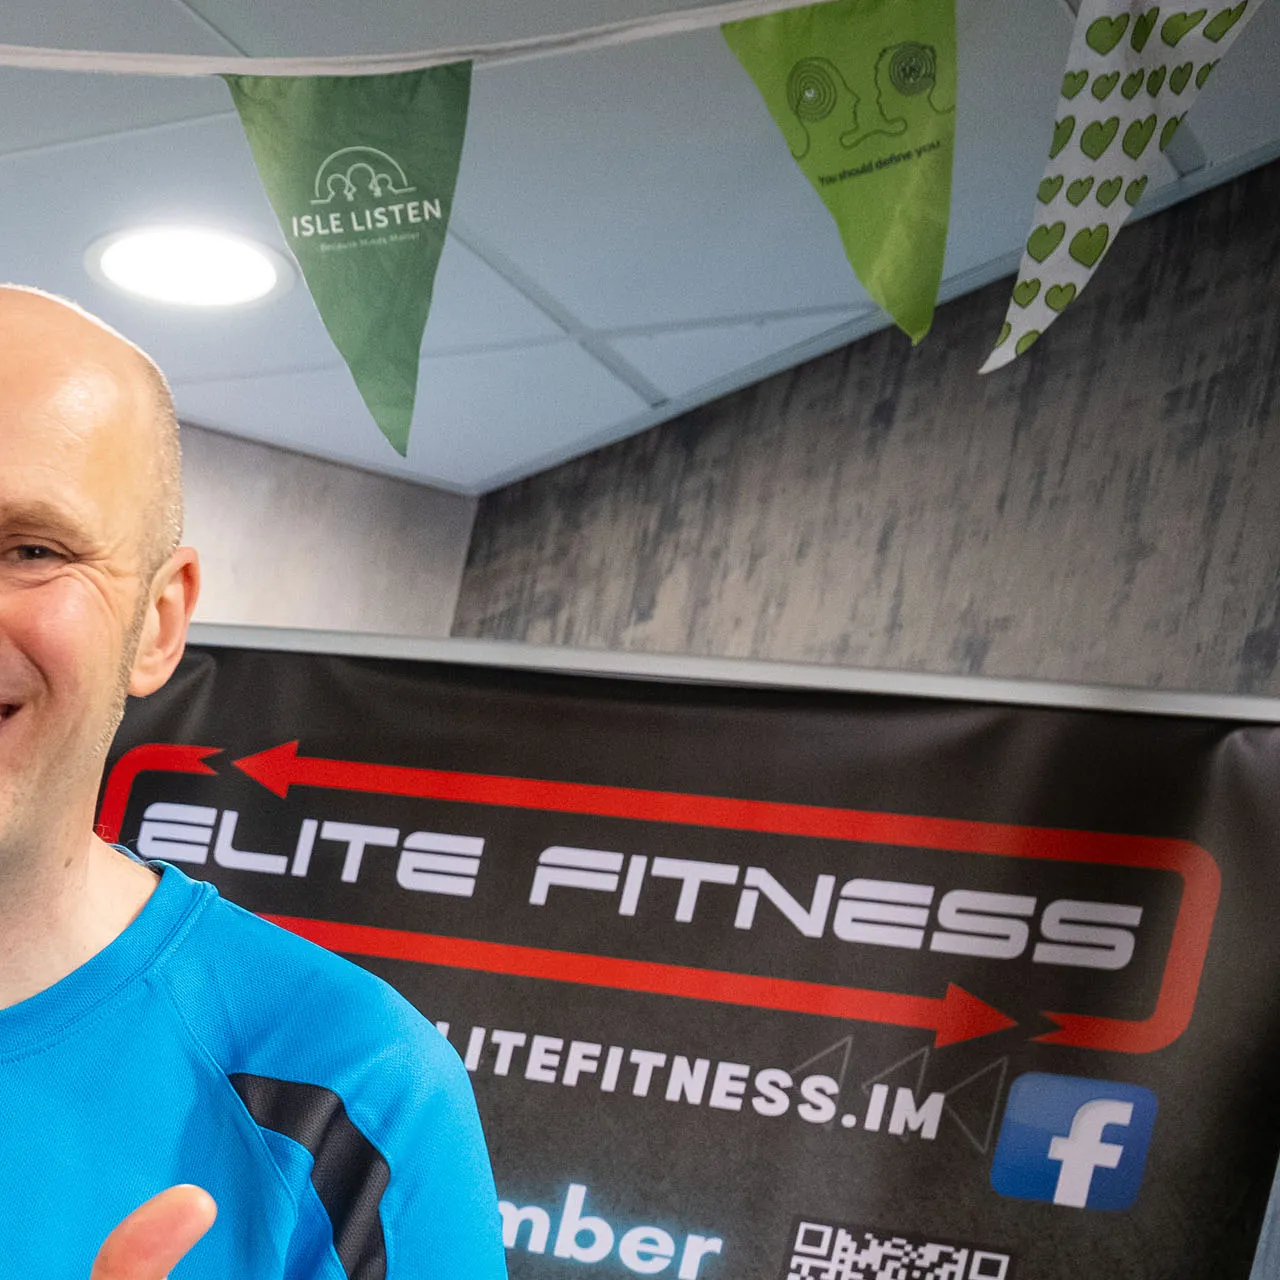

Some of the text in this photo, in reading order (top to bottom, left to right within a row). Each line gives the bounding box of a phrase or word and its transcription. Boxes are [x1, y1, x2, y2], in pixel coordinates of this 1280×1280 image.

[292, 198, 442, 238] ISLE LISTEN
[137, 802, 1144, 971] ELITE FITNESS
